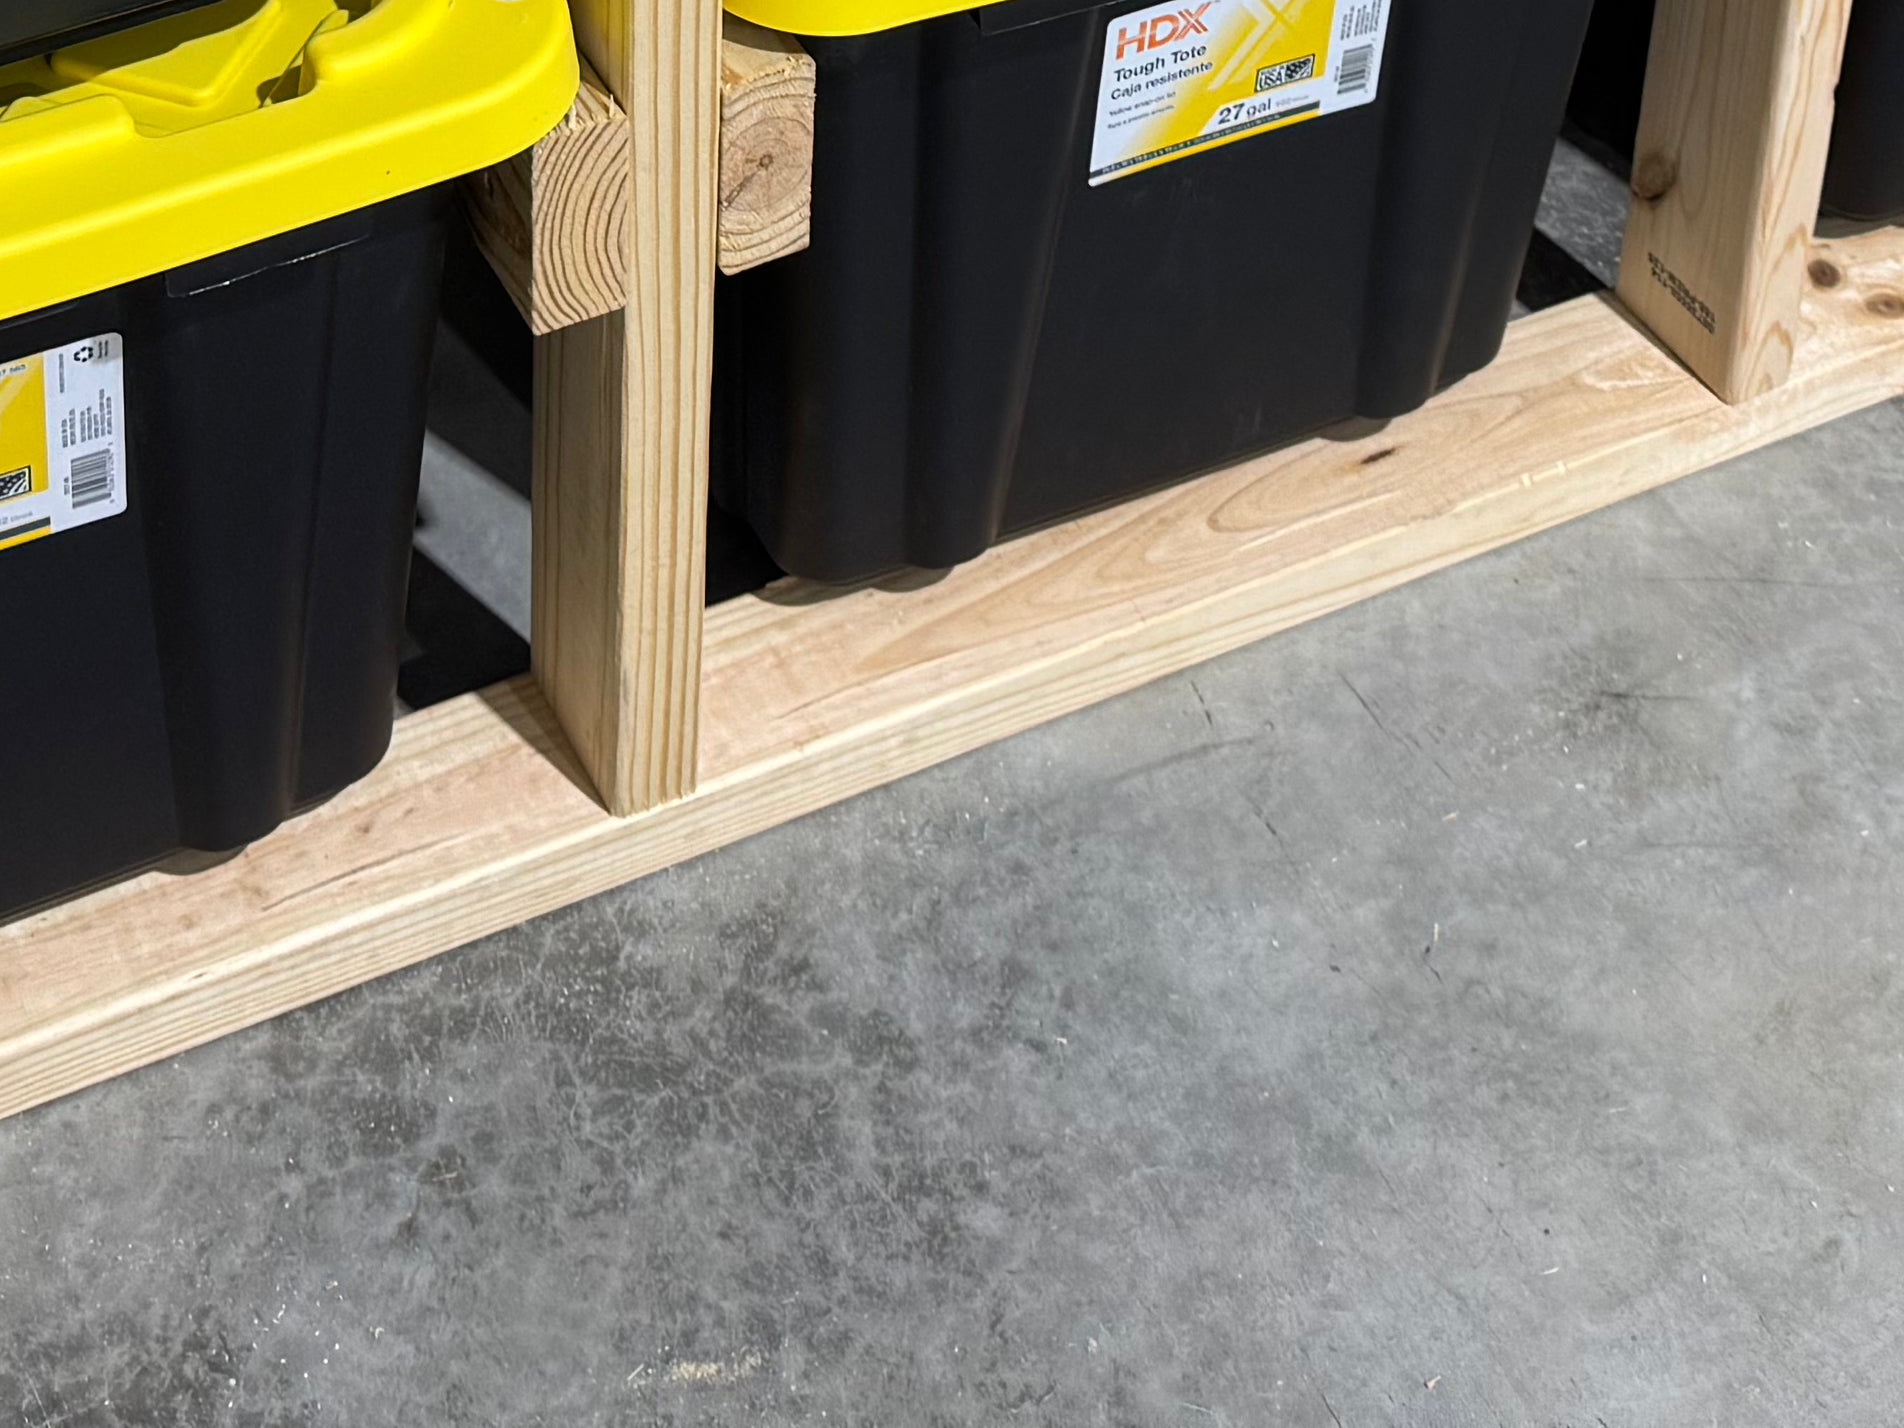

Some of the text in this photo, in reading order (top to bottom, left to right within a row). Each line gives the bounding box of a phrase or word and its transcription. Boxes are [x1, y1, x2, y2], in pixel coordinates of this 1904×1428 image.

[1115, 1, 1212, 60] HDX
[1110, 61, 1213, 100] Caja resistente
[1114, 45, 1206, 82] Tough Tote
[1217, 102, 1244, 124] 27
[1246, 97, 1271, 119] gal
